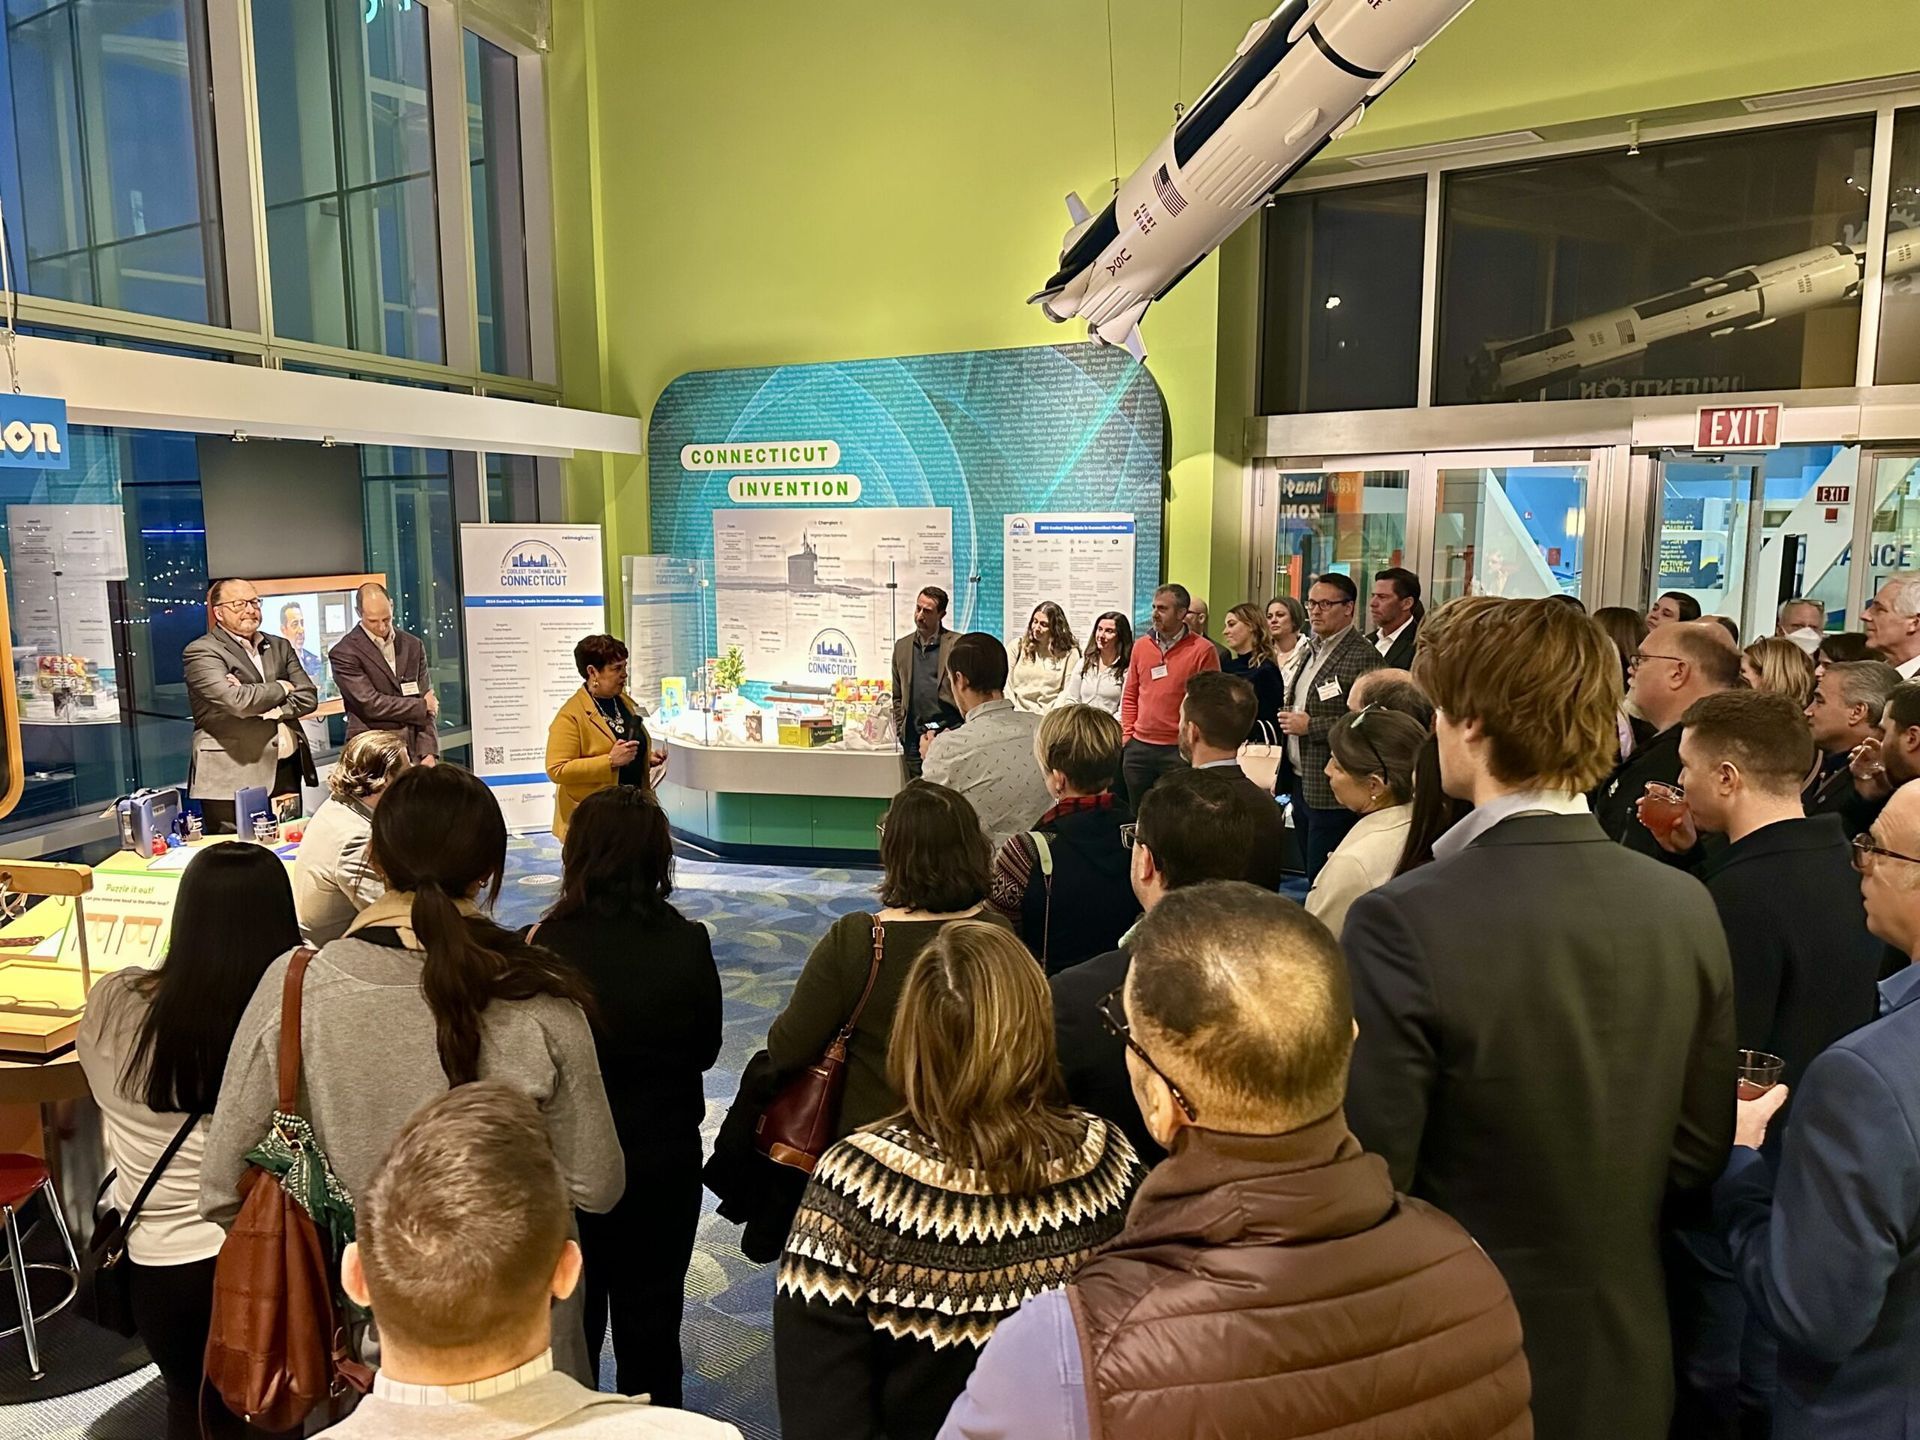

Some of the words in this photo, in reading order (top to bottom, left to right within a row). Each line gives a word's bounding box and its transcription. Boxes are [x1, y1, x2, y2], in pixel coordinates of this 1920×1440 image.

[1133, 209, 1151, 236] STAGE
[1140, 203, 1157, 228] FIRST
[1106, 248, 1132, 276] USA
[1710, 409, 1769, 445] EXIT
[691, 446, 828, 465] CONNECTICUT
[739, 481, 849, 496] INVENTION
[1821, 487, 1847, 501] EXIT
[501, 575, 567, 586] CONNECTICUT
[808, 663, 857, 676] CONNECTICUT
[106, 884, 129, 893] Puzzle
[138, 886, 154, 894] out!
